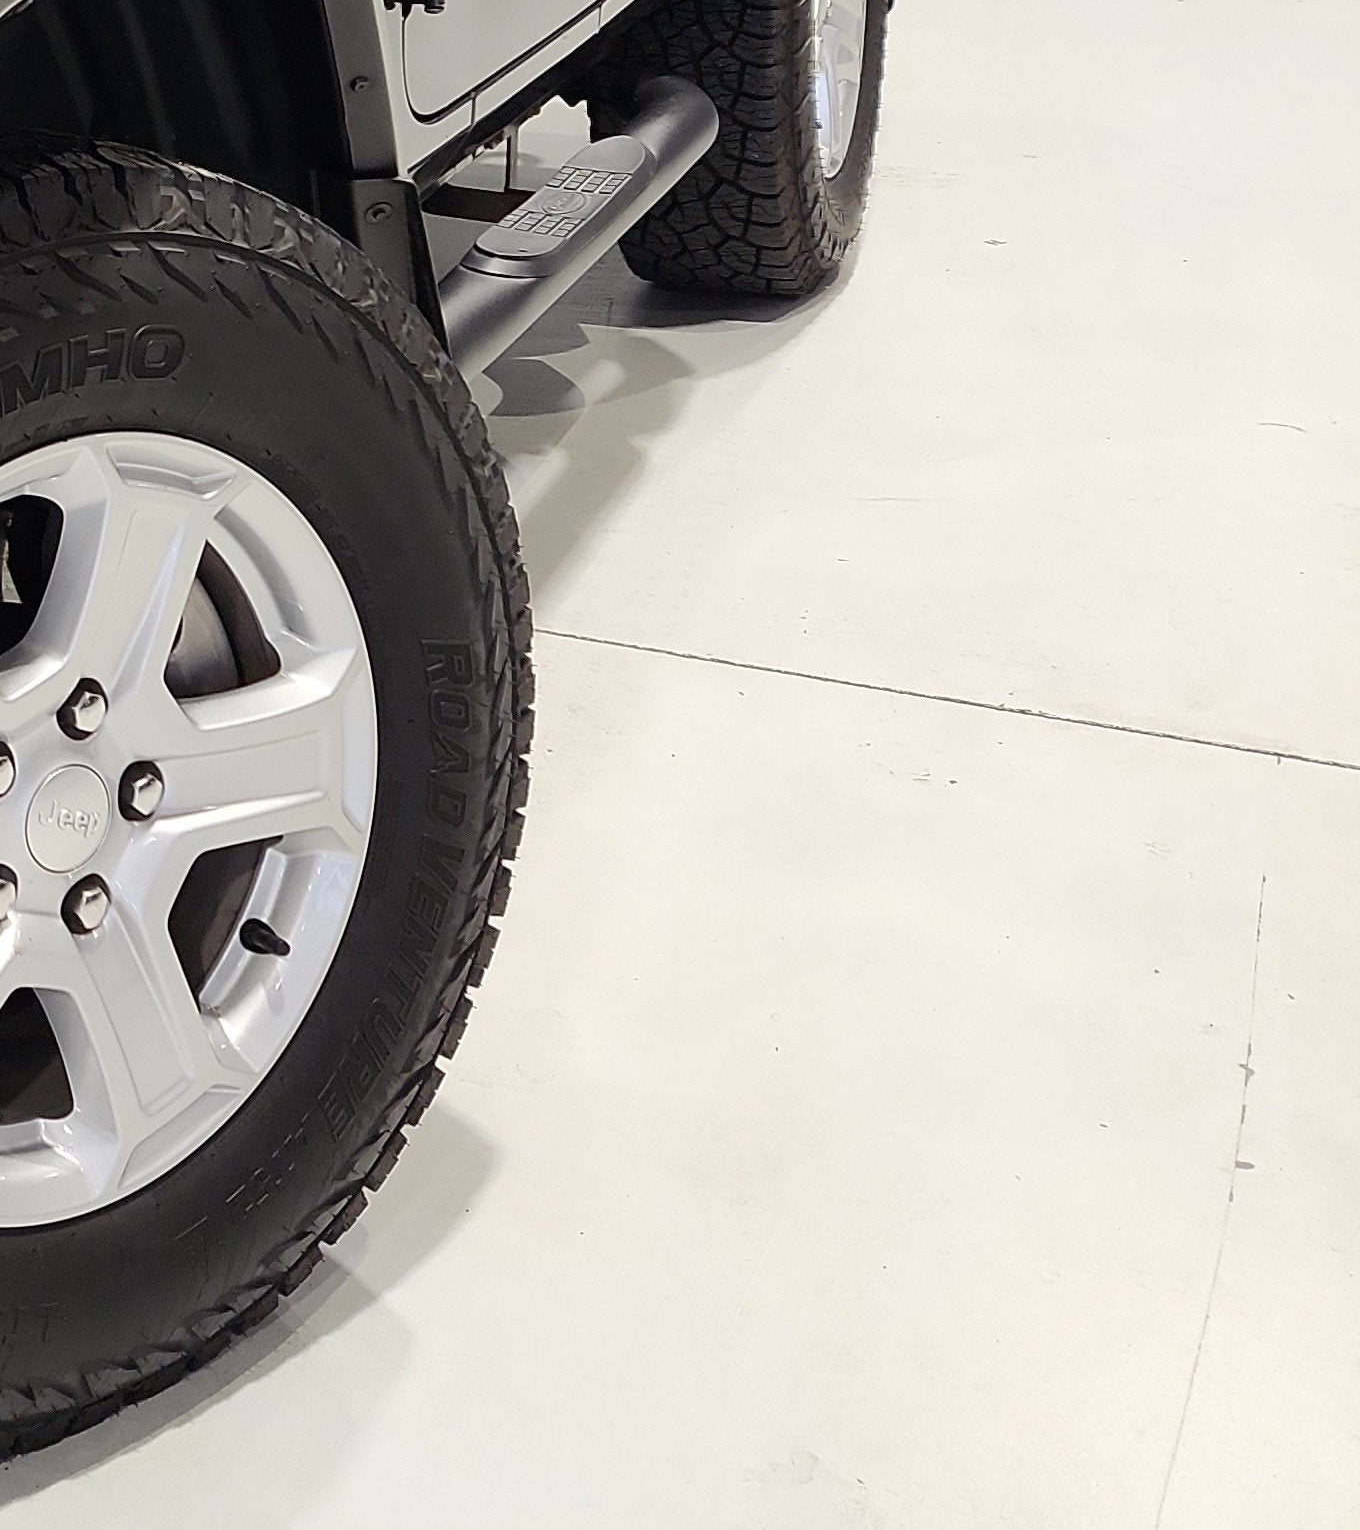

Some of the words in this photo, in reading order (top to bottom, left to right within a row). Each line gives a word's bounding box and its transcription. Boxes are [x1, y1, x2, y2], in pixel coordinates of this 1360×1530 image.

[38, 799, 101, 838] Jeep
[420, 638, 475, 827] ROAD
[317, 831, 466, 1143] VENTURE
